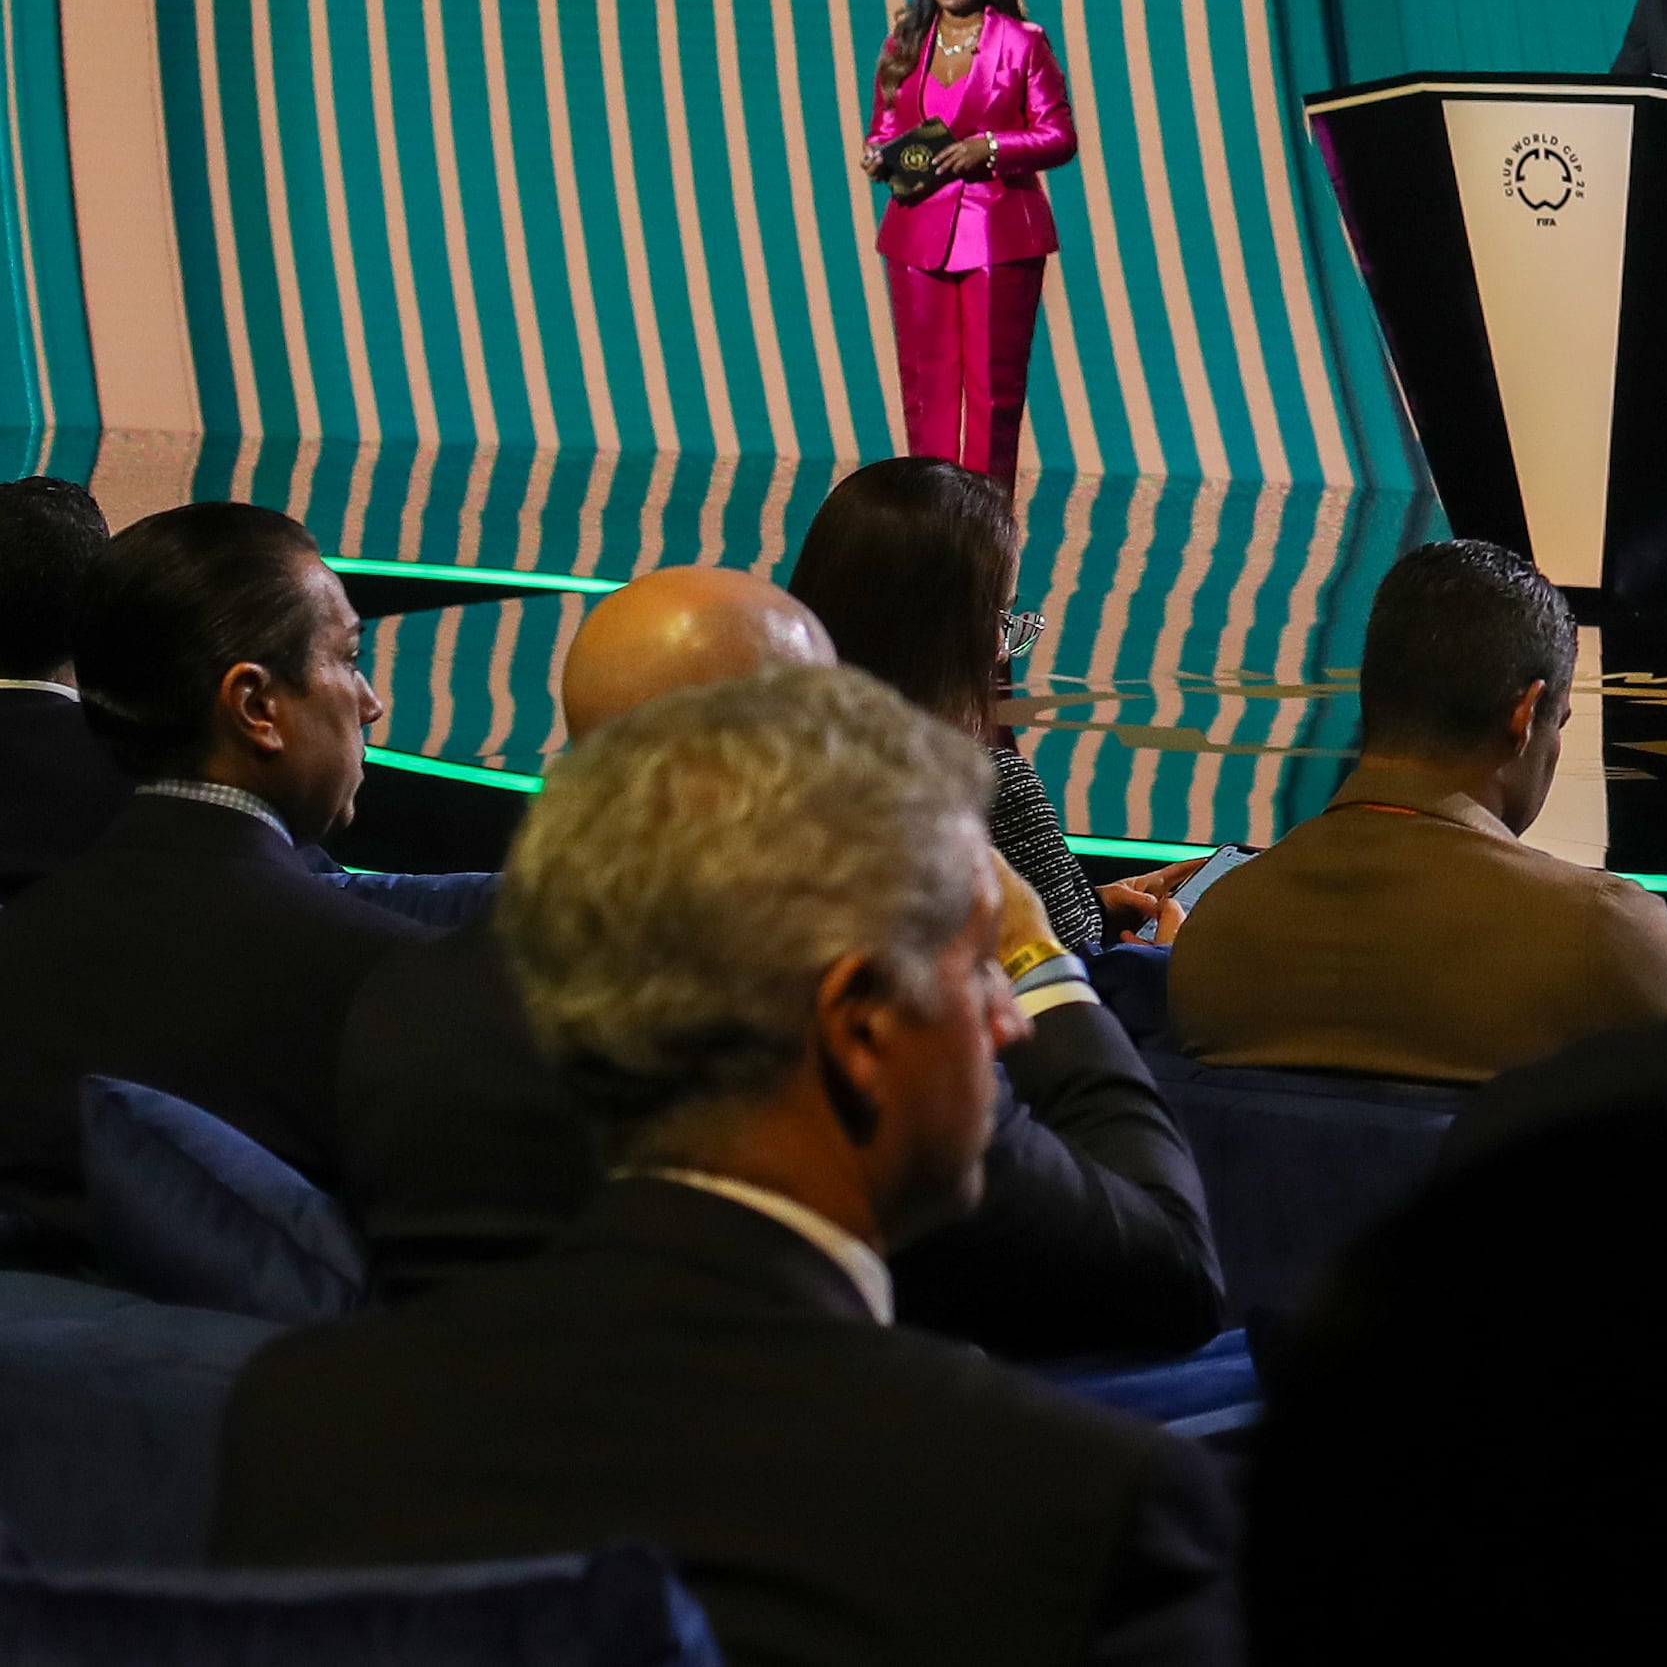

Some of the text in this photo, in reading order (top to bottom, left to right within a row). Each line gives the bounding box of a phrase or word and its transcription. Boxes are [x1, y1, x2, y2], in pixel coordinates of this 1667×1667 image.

[1503, 157, 1513, 197] CLUB
[1512, 134, 1558, 153] WORLD
[1563, 146, 1582, 172] CUP
[1537, 218, 1556, 226] FIFA
